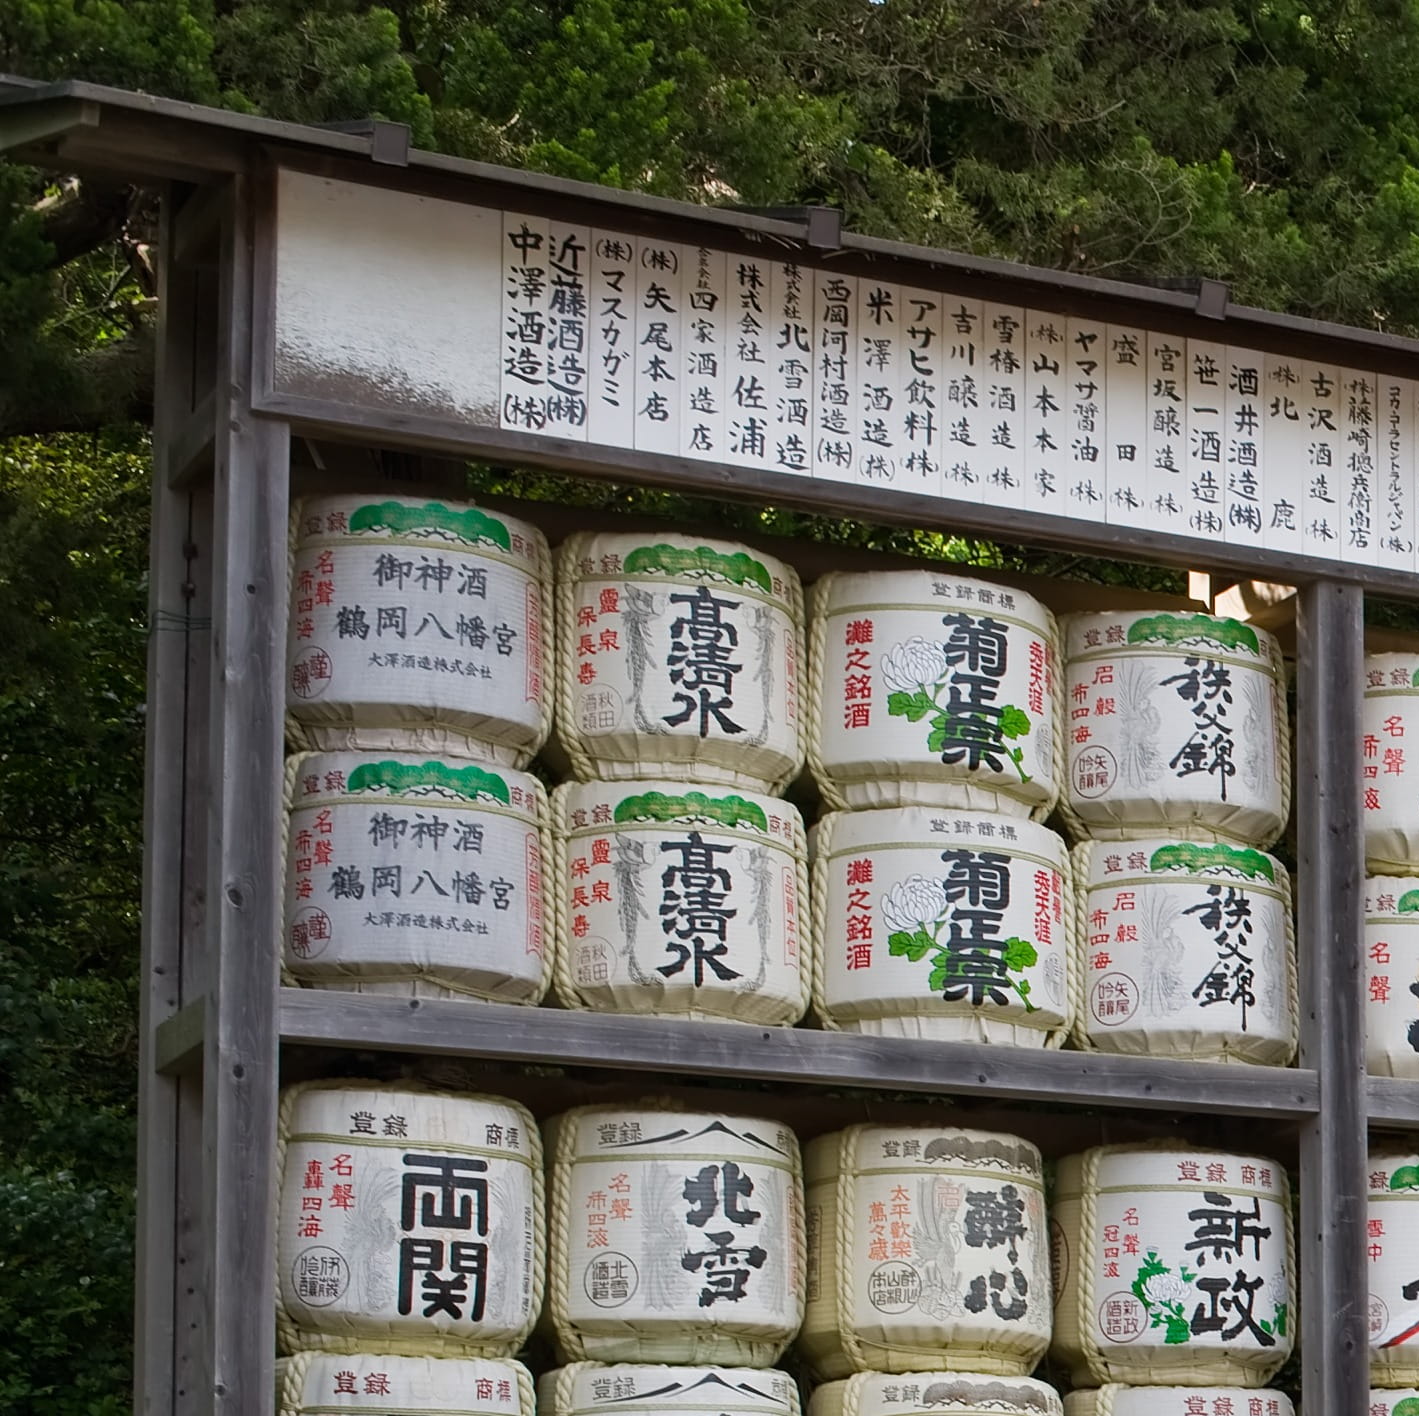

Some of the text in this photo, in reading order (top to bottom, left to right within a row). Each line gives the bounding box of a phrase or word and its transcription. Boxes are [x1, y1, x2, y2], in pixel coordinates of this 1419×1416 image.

[729, 263, 768, 458] 株式会社佐浦
[336, 605, 518, 657] 鶴岡八幡宮
[374, 553, 487, 599] 御神酒
[369, 653, 492, 680] 大澤酒造株式会社
[941, 613, 1009, 771] 菊正宗
[1157, 656, 1236, 801] 秩父錦
[327, 864, 515, 910] 鶴岡八幡宮
[369, 813, 483, 854] 御神酒
[941, 850, 1012, 1006] 菊正宗
[1182, 885, 1256, 1031] 秩父錦
[399, 1154, 488, 1322] 両関
[681, 1161, 768, 1306] 北雪
[1184, 1192, 1275, 1347] 新政
